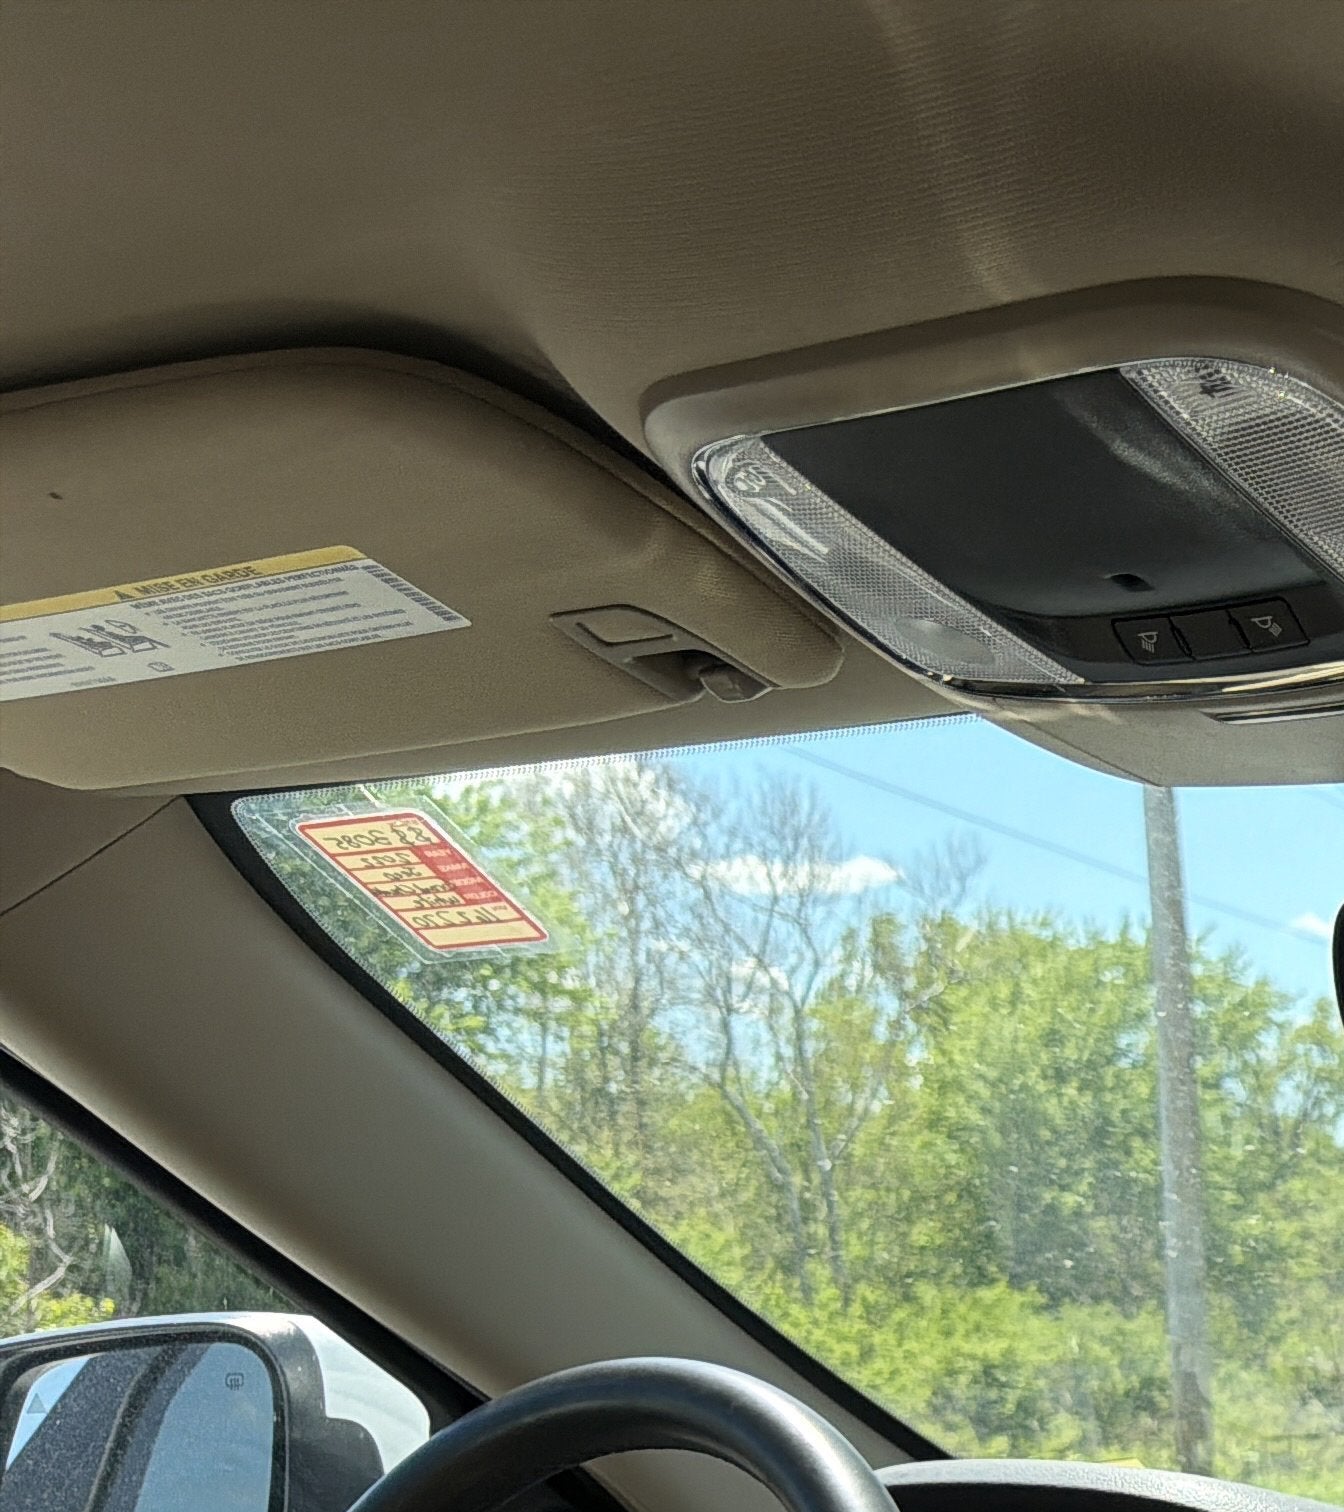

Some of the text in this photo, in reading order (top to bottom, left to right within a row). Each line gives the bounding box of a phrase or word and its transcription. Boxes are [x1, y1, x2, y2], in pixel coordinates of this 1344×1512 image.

[134, 566, 263, 596] MISE EN GARDE
